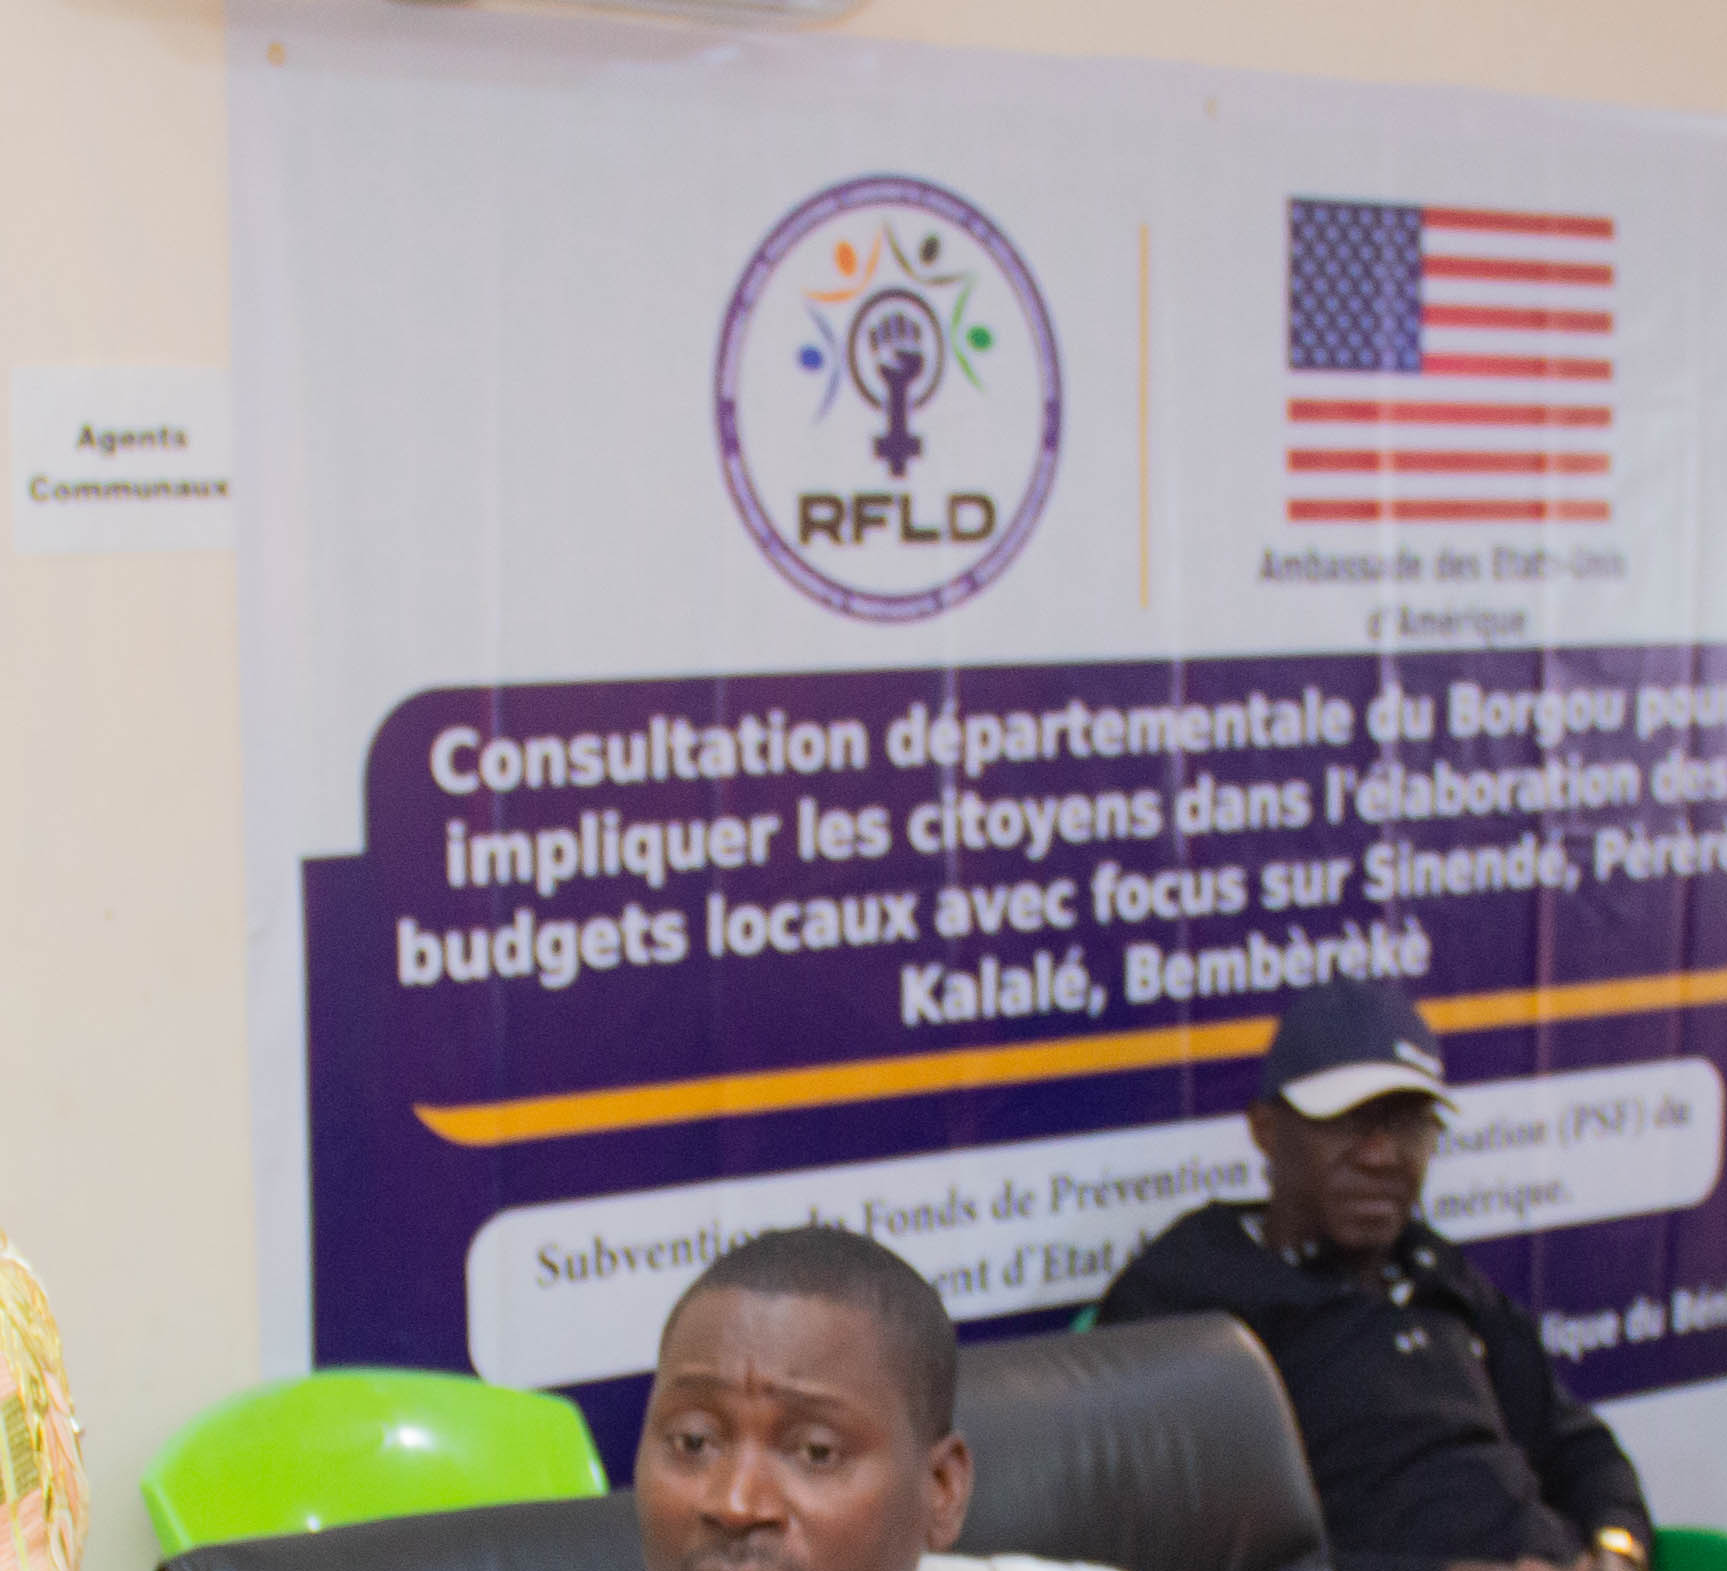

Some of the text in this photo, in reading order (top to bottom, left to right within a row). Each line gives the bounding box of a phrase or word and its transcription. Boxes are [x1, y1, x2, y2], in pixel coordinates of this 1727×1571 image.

[77, 424, 189, 455] Agents
[29, 474, 229, 502] Communaux
[797, 494, 997, 545] RFLD
[430, 709, 869, 795] Consultation
[885, 687, 1353, 778] départementale
[1368, 683, 1434, 743] du
[1448, 680, 1626, 747] Borgou
[446, 809, 779, 896] impliquer
[797, 795, 891, 862] les
[907, 783, 1163, 860] citoyens
[1177, 775, 1311, 836] dans
[1326, 753, 1640, 825] l'élaboration
[397, 904, 689, 990] budgets
[707, 893, 919, 958] locaux
[934, 877, 1076, 939] avec
[1092, 859, 1248, 925] focus
[1262, 856, 1353, 912] sur
[1364, 832, 1581, 903] Sinendé,
[901, 945, 1105, 1028] Kalalé,
[862, 1183, 977, 1237] Fonds
[992, 1178, 1036, 1220] de
[1049, 1155, 1250, 1213] Prévention
[1433, 1179, 1575, 1221] mérique.
